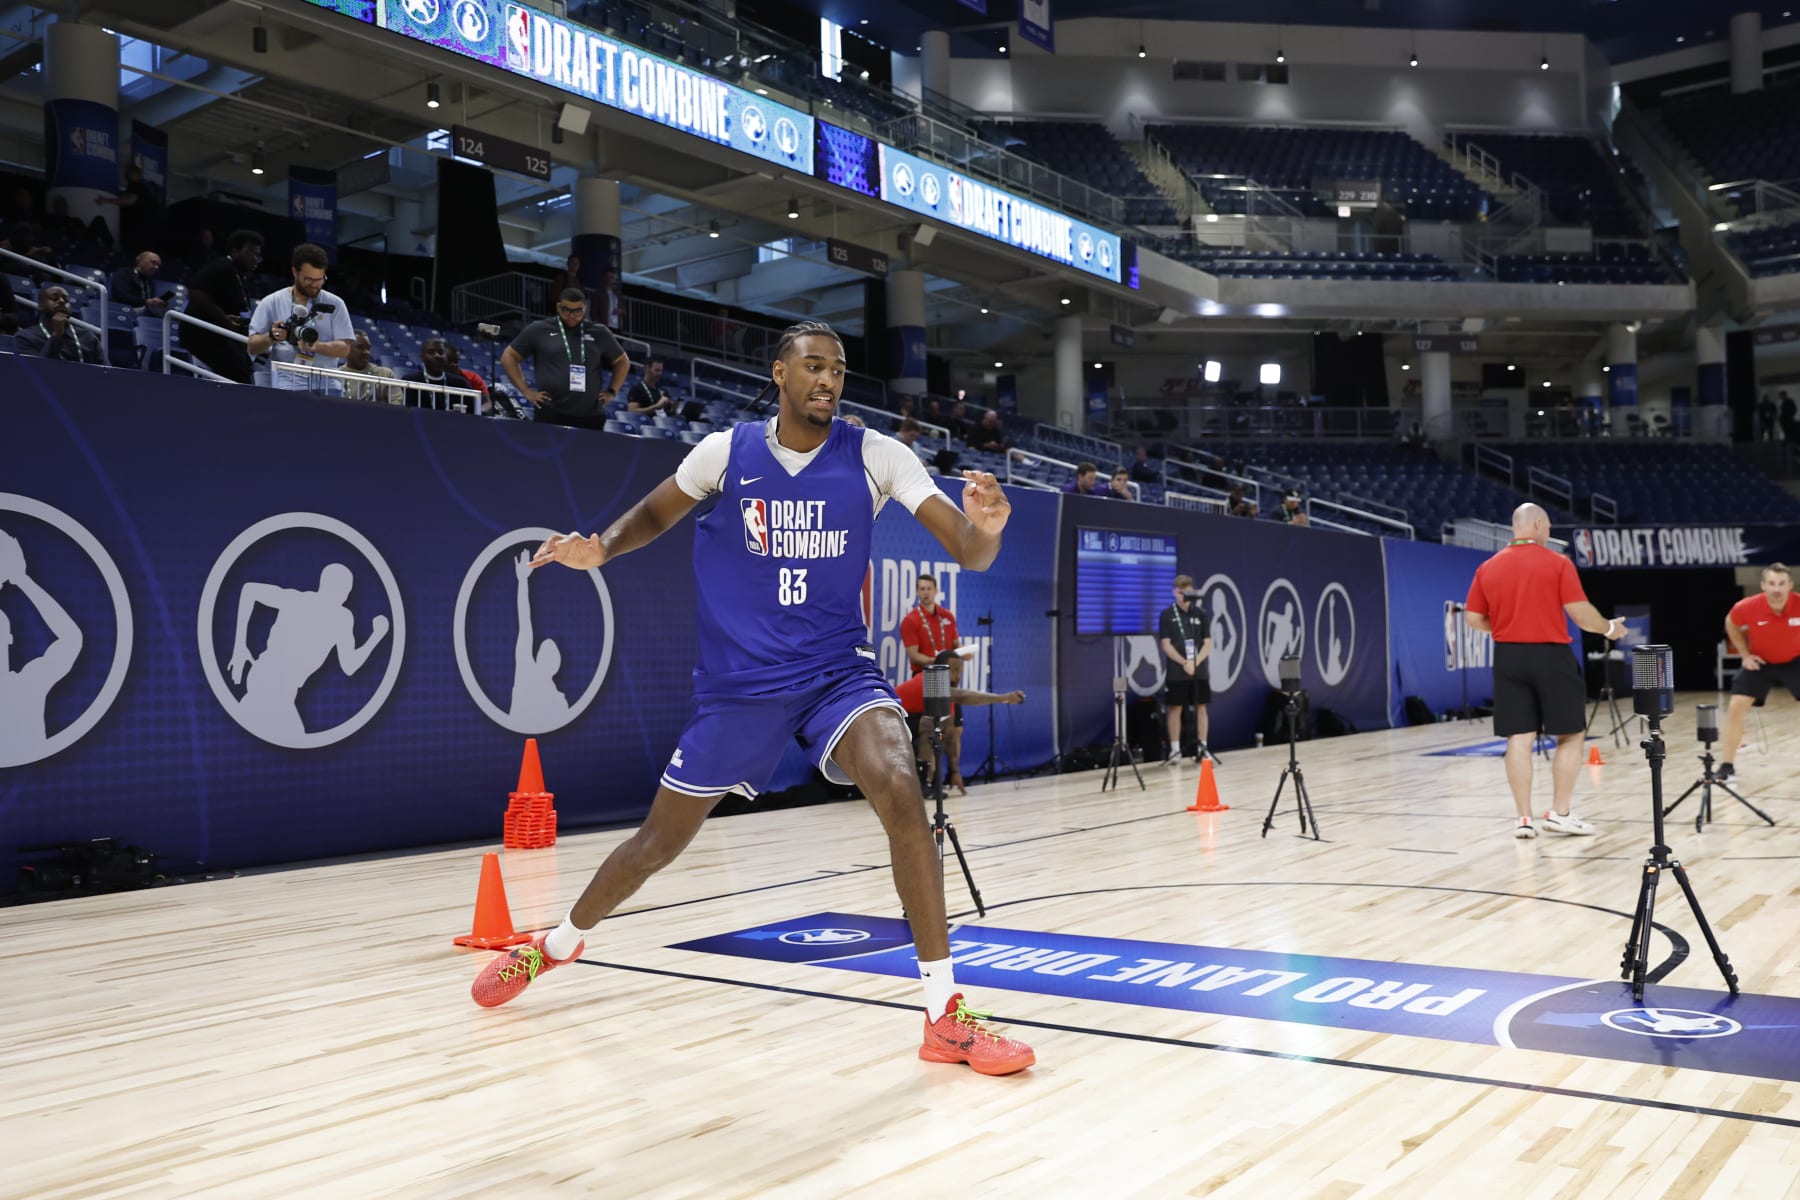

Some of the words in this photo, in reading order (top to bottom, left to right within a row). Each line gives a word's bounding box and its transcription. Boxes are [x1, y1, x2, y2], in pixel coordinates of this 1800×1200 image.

[533, 15, 618, 100] DRAFT
[621, 50, 730, 140] COMBINE
[459, 137, 484, 156] 124
[525, 156, 548, 175] 125
[1339, 191, 1356, 200] 229
[1360, 191, 1377, 200] 230
[962, 180, 1010, 239] DRAFT
[1011, 200, 1073, 262] COMBINE
[832, 246, 848, 262] 125
[1416, 340, 1432, 351] 127
[771, 500, 826, 530] DRAFT
[772, 529, 849, 559] COMBINE
[1592, 528, 1655, 567] DRAFT
[1658, 527, 1748, 565] COMBINE
[778, 567, 808, 606] 83
[1086, 958, 1309, 997] LANE
[1293, 977, 1489, 1017] PRO
